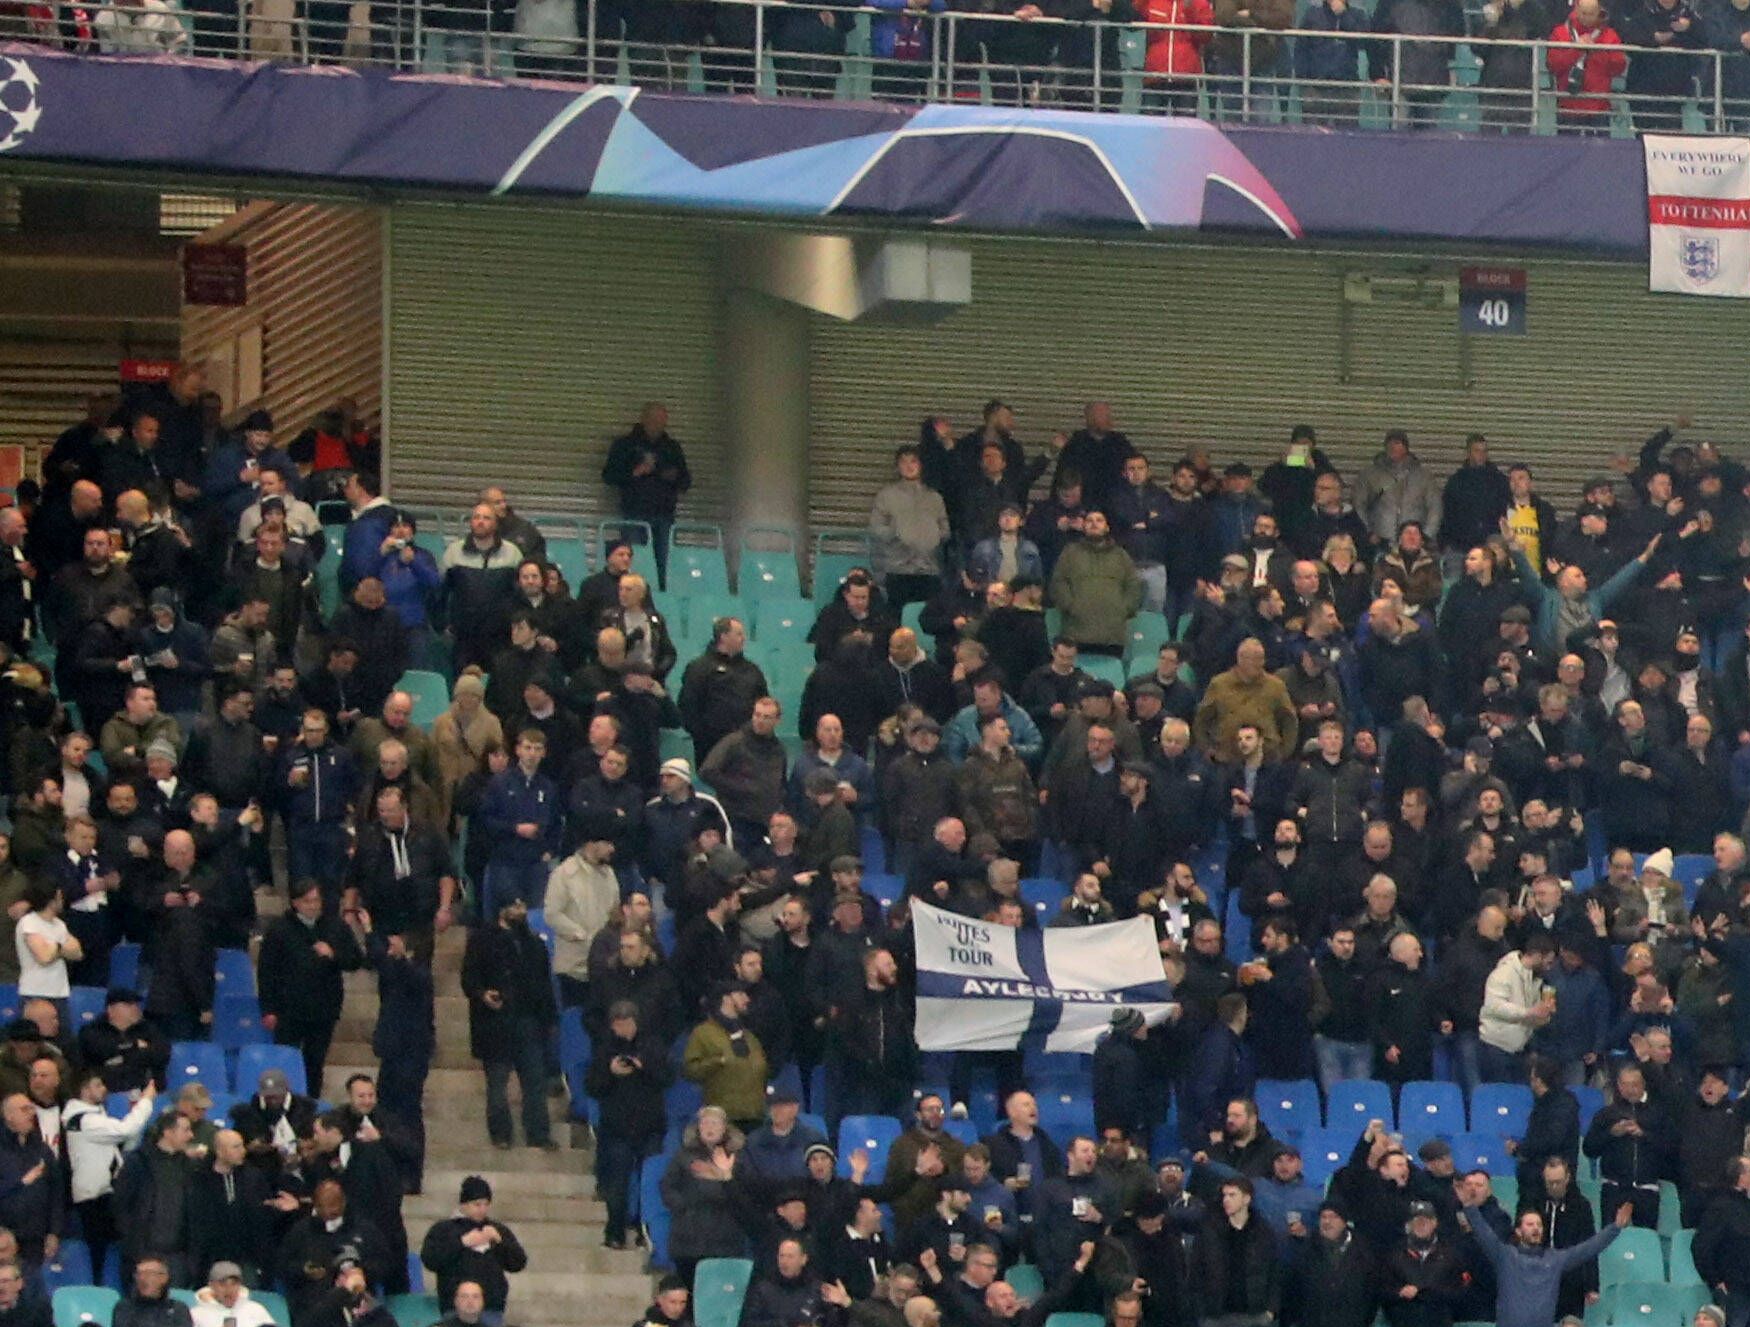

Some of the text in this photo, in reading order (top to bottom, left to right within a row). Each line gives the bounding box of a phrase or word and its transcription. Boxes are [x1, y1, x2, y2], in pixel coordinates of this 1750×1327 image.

[1652, 151, 1743, 163] EVERYWHERE
[1678, 165, 1722, 176] WE GO
[1478, 300, 1510, 326] 40
[949, 948, 993, 966] TOUR
